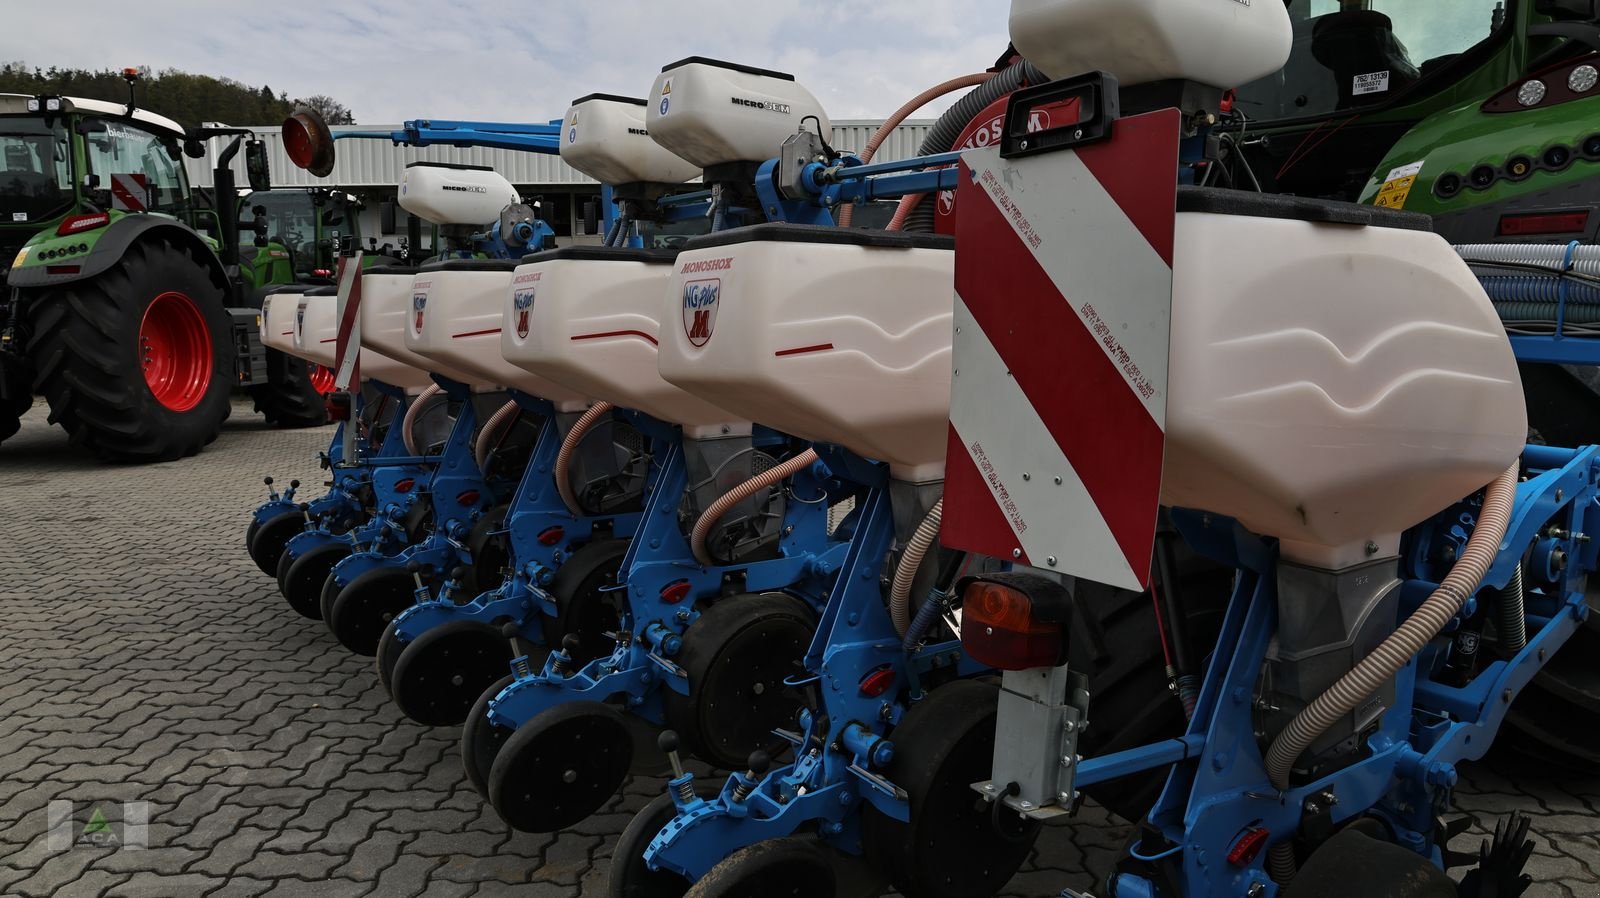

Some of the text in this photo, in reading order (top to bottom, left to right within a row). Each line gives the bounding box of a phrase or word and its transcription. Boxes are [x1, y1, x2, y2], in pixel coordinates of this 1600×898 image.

[731, 97, 790, 114] MICROSEM
[628, 127, 650, 136] MIC
[999, 197, 1011, 213] GEKA
[1010, 203, 1022, 219] GEKA
[681, 257, 734, 274] MONOSHOX
[684, 285, 698, 309] NG
[690, 310, 709, 338] M
[1098, 321, 1110, 335] ESC
[1080, 307, 1090, 318] DIN
[1102, 336, 1117, 354] GEKA
[1123, 364, 1134, 377] ESC
[1115, 344, 1130, 362] GEKA
[1144, 382, 1154, 394] DIN
[988, 473, 999, 490] GEKA
[999, 482, 1009, 499] GEKA
